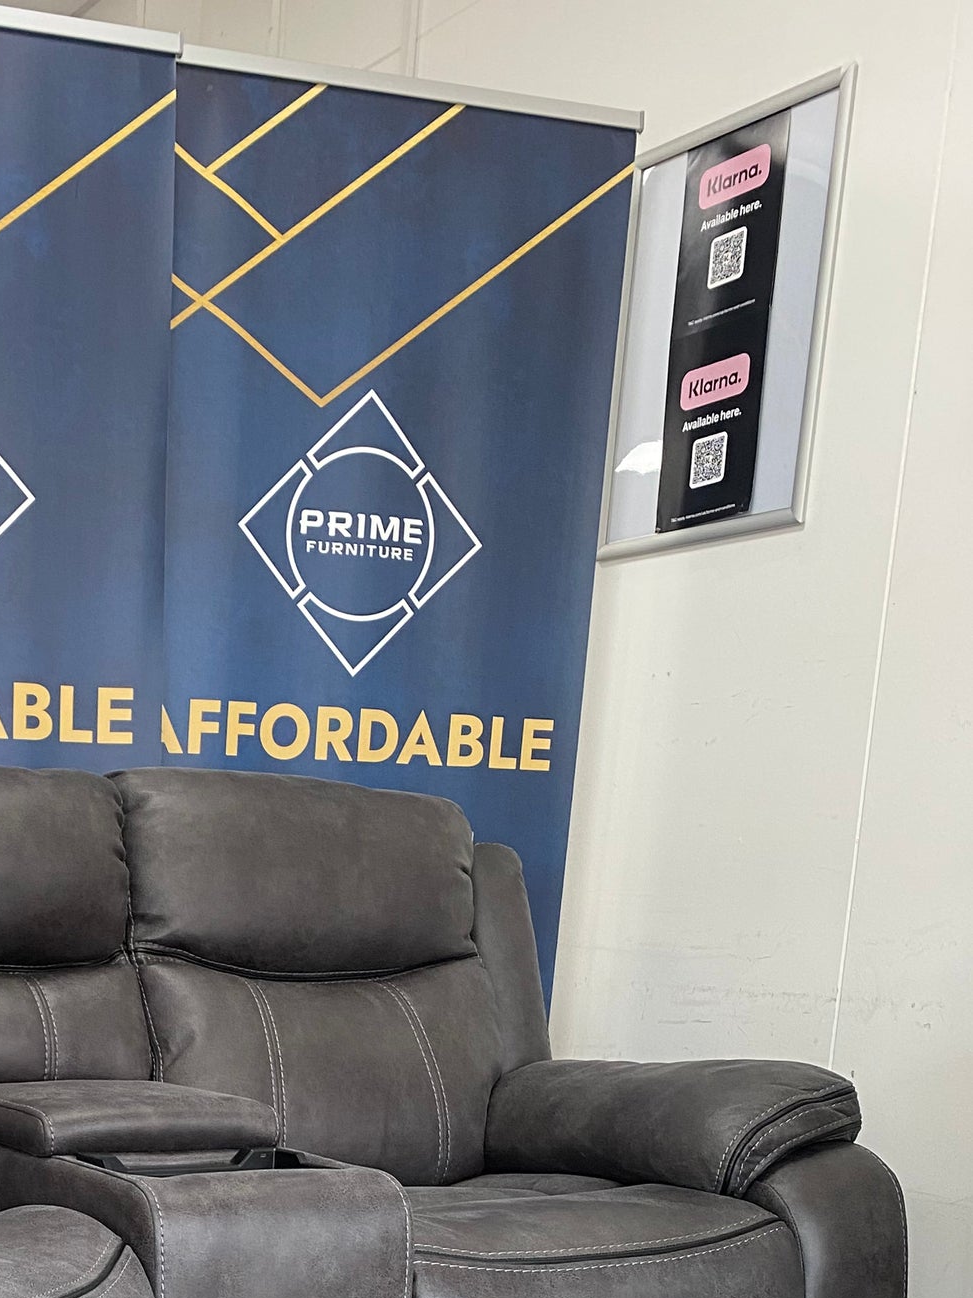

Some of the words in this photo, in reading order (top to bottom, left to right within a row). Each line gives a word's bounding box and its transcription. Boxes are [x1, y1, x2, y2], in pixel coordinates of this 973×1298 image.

[707, 163, 762, 198] Klarna.
[700, 208, 739, 233] Available
[739, 199, 763, 217] here.
[688, 371, 742, 399] Klarna.
[682, 412, 719, 433] Available
[720, 407, 742, 421] here.
[299, 508, 424, 545] PRIME
[305, 539, 414, 562] FURNITURE
